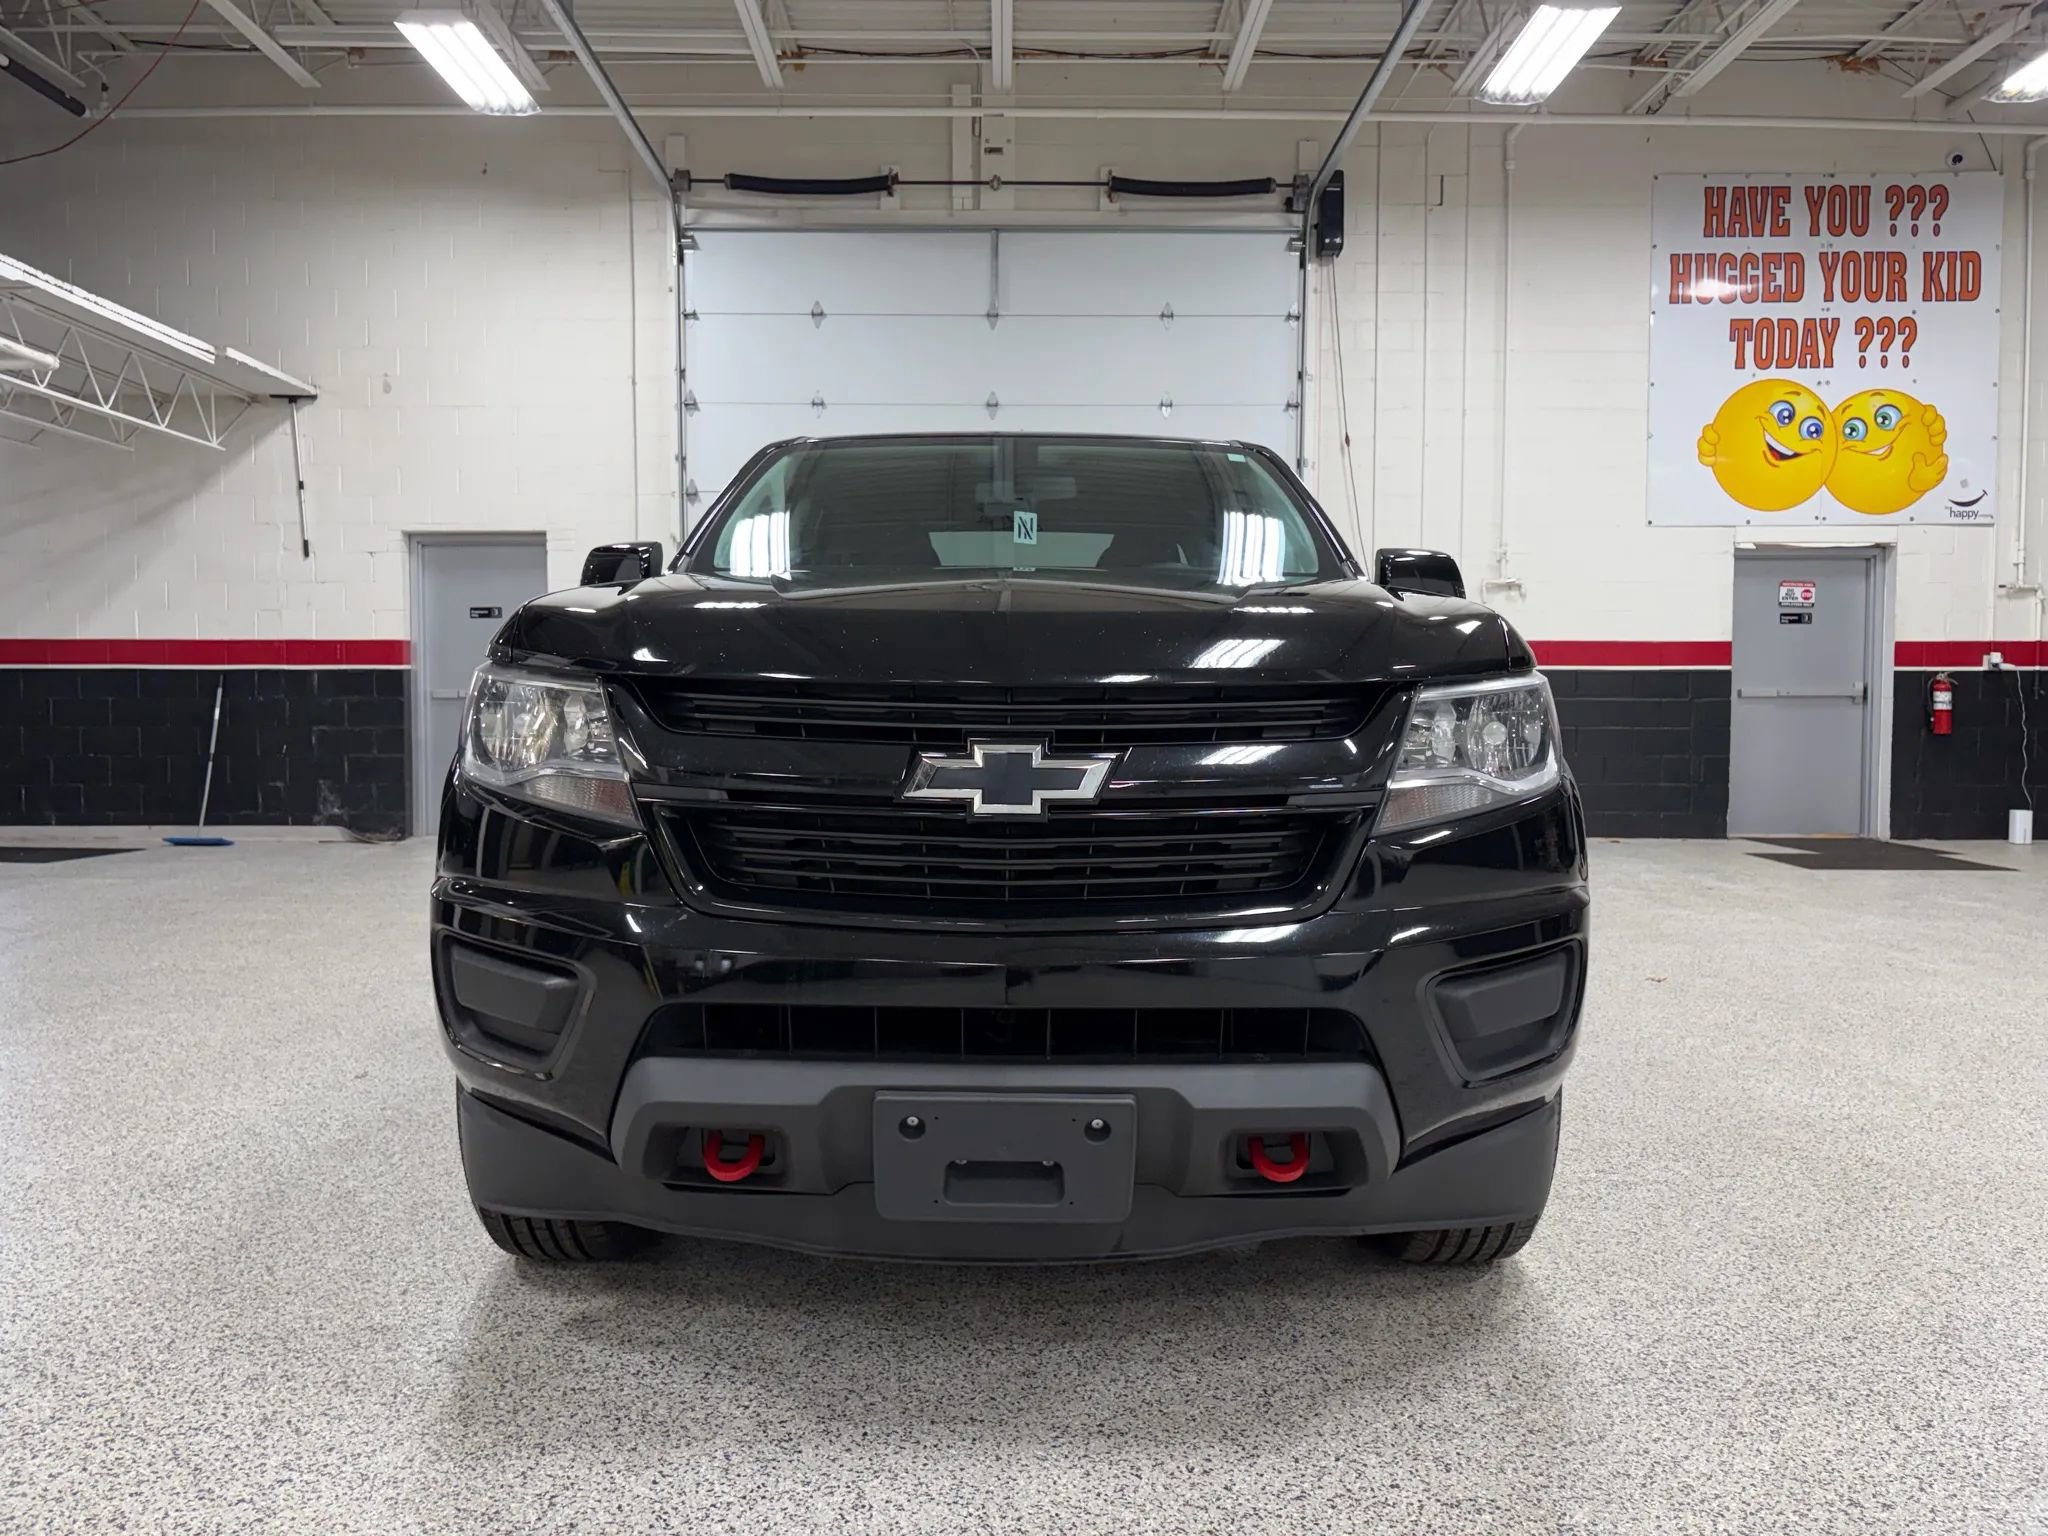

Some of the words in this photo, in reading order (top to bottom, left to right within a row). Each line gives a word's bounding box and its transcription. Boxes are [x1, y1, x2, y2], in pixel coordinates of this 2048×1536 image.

[1703, 186, 1791, 237] HAVE
[1805, 185, 1871, 237] YOU
[1885, 184, 1950, 237] ???
[1669, 252, 1804, 305] HUGGED
[1819, 251, 1907, 303] YOUR
[1921, 250, 1982, 302] KID
[1729, 318, 1840, 370] TODAY
[1854, 316, 1918, 369] ???
[1949, 506, 1979, 520] happy
